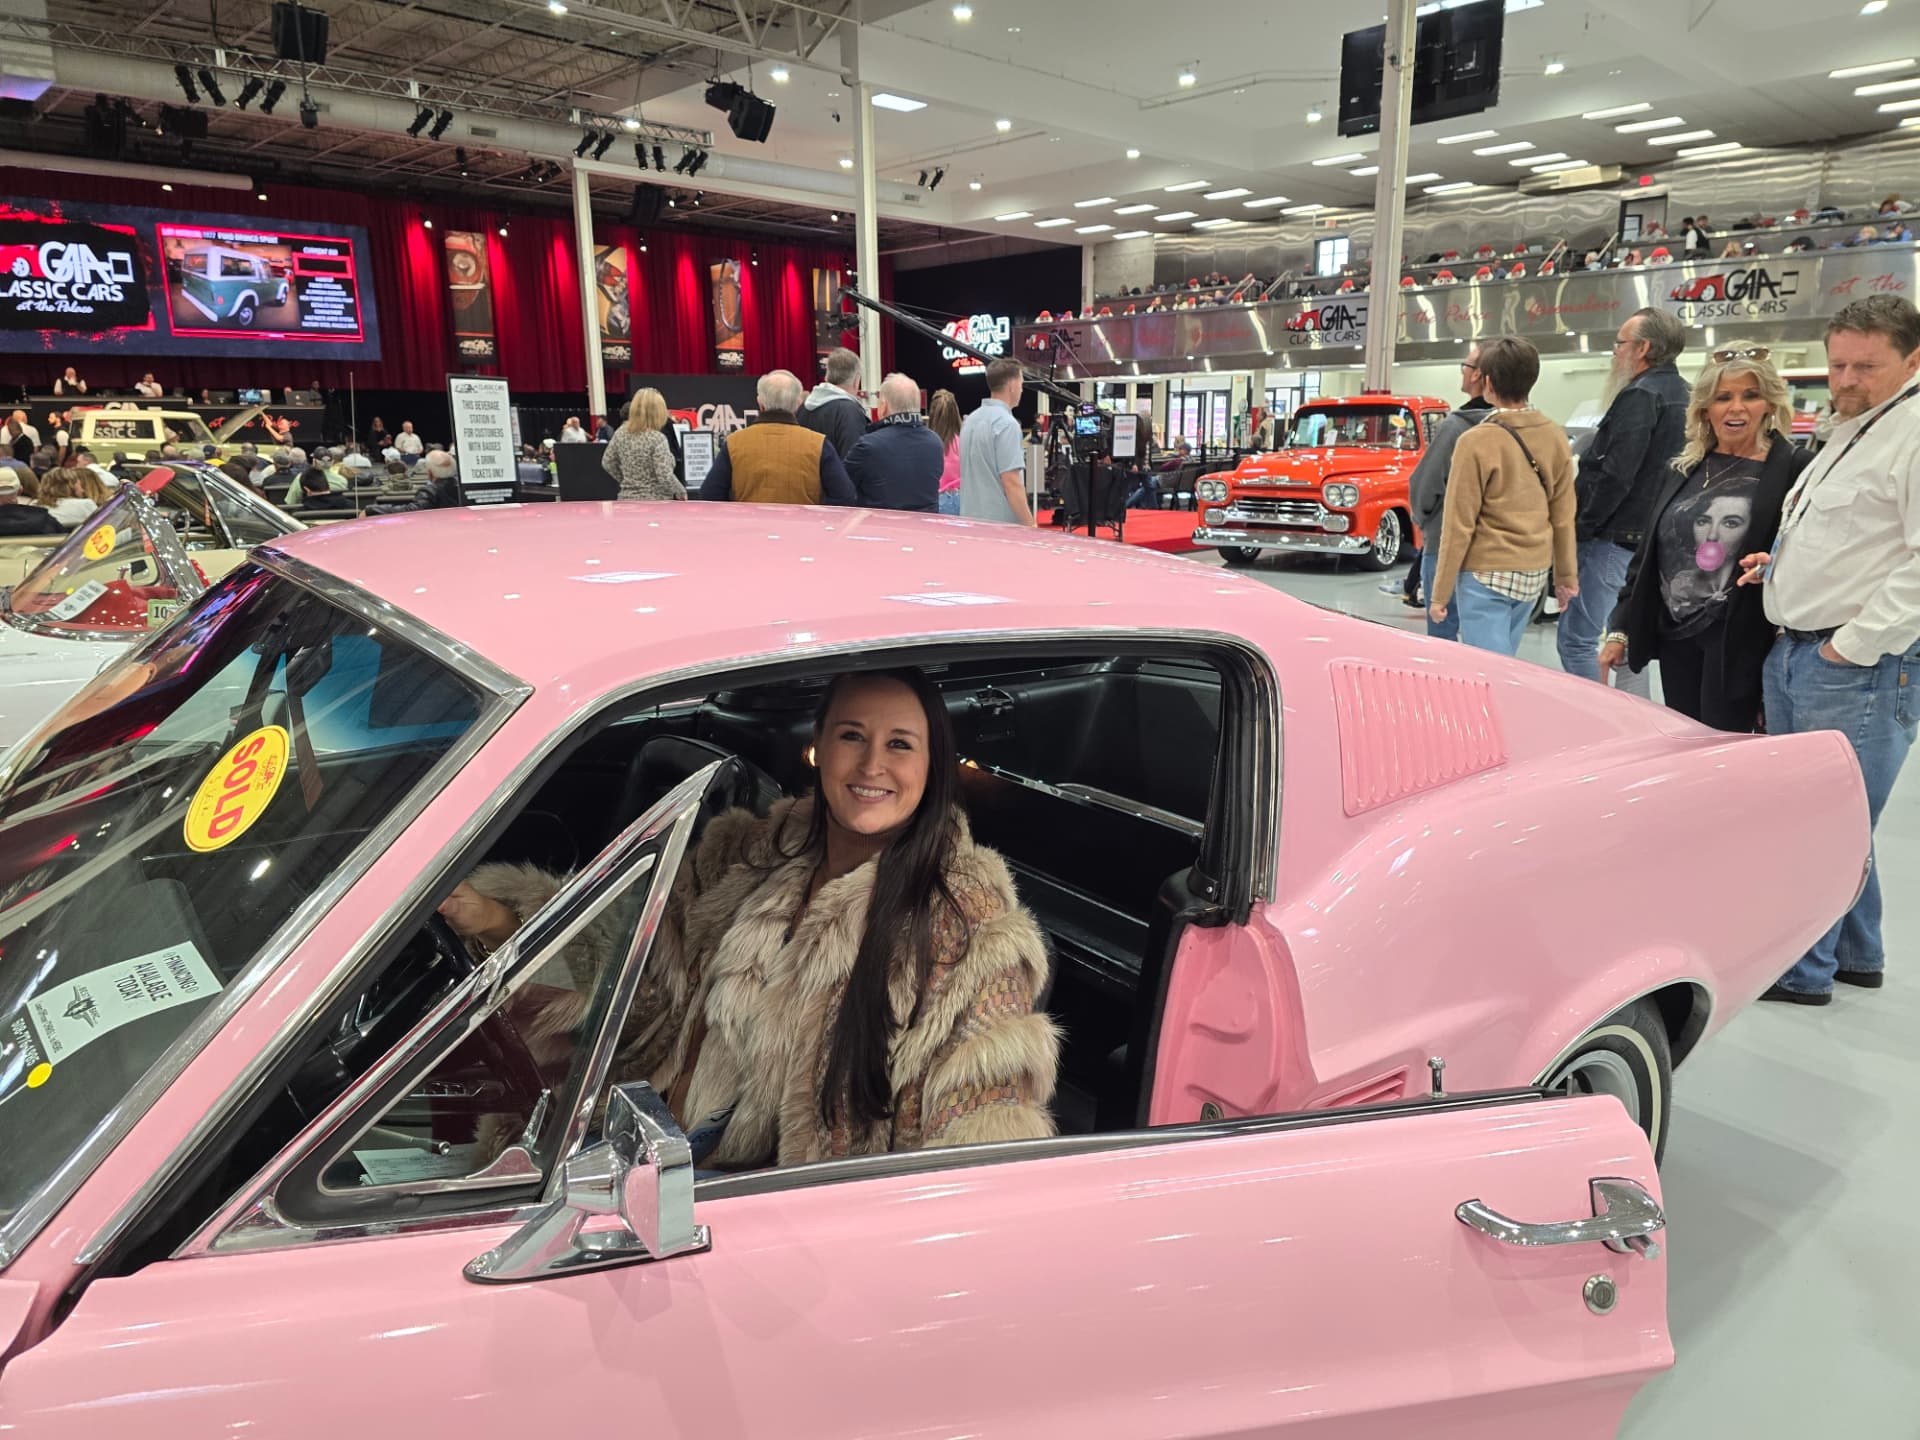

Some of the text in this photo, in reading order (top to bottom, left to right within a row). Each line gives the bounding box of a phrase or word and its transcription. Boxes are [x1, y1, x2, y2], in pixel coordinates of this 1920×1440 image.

[0, 279, 124, 301] ASSIC CARS
[1677, 299, 1788, 319] CLASSIC CARS
[1289, 329, 1362, 346] CLASSIC CARS
[207, 736, 266, 839] SOLD
[134, 962, 172, 1002] AVAILABLE
[163, 954, 195, 991] FINANCING
[114, 974, 145, 1002] TODAY
